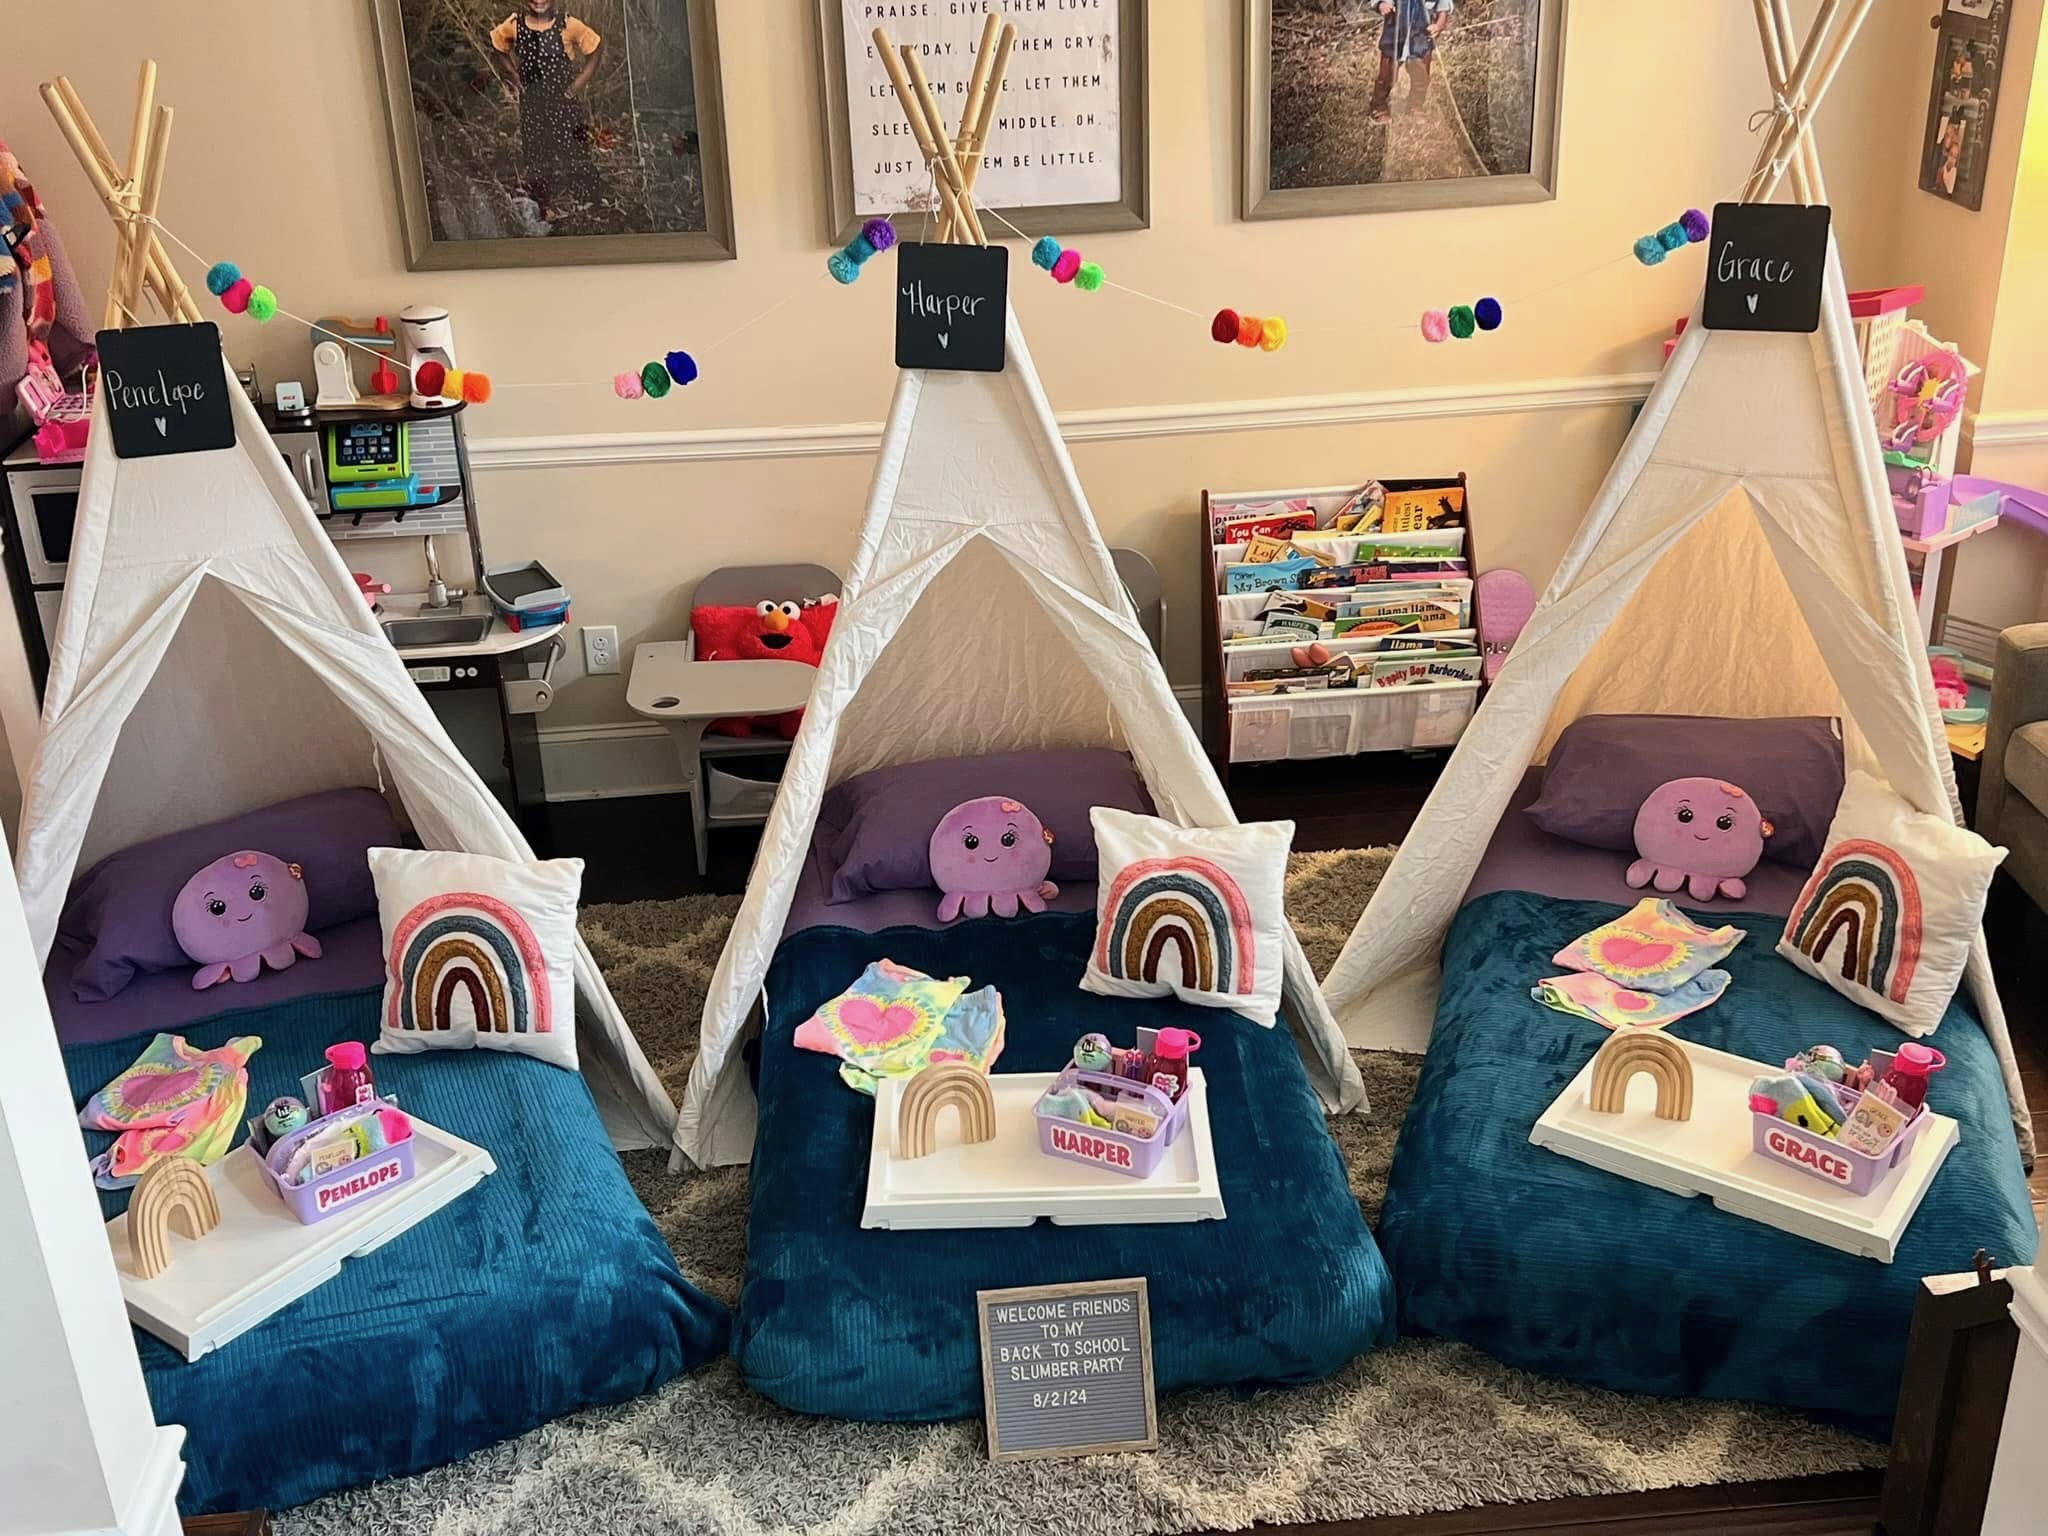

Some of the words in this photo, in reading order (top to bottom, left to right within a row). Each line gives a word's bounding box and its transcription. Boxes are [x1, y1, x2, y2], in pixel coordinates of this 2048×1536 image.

[950, 0, 989, 15] GIVE
[1002, 0, 1046, 13] THEM
[1059, 0, 1100, 10] LOVE
[866, 42, 958, 59] EDAY.
[869, 83, 895, 98] LET
[908, 82, 946, 95] TEM
[1025, 76, 1051, 91] LET
[1062, 74, 1101, 89] THEM
[871, 122, 910, 136] SLEE
[874, 161, 913, 174] JUST
[1013, 154, 1030, 168] BE
[1041, 151, 1103, 166] LITTLE.
[1717, 240, 1795, 283] Grace
[902, 279, 987, 327] Harper
[106, 368, 205, 415] Penelope
[1413, 504, 1424, 530] ear
[1230, 527, 1250, 539] You
[1250, 525, 1271, 537] Can
[1254, 577, 1288, 589] Brown
[1423, 613, 1446, 622] ama
[1052, 1127, 1131, 1167] HARPER
[1768, 1131, 1849, 1180] GRACE
[318, 1162, 400, 1208] PENELOPE
[996, 1303, 1067, 1323] WELCOME
[1072, 1298, 1131, 1317] FRIENDS
[1040, 1323, 1059, 1339] TO
[1064, 1321, 1085, 1337] MY
[1000, 1343, 1042, 1362] BACK
[1051, 1342, 1069, 1357] TO
[1074, 1337, 1131, 1355] SCHOOL
[1010, 1360, 1080, 1381] SLUMBER
[1083, 1357, 1125, 1376] PARTY
[1033, 1389, 1088, 1409] 8/2/24
